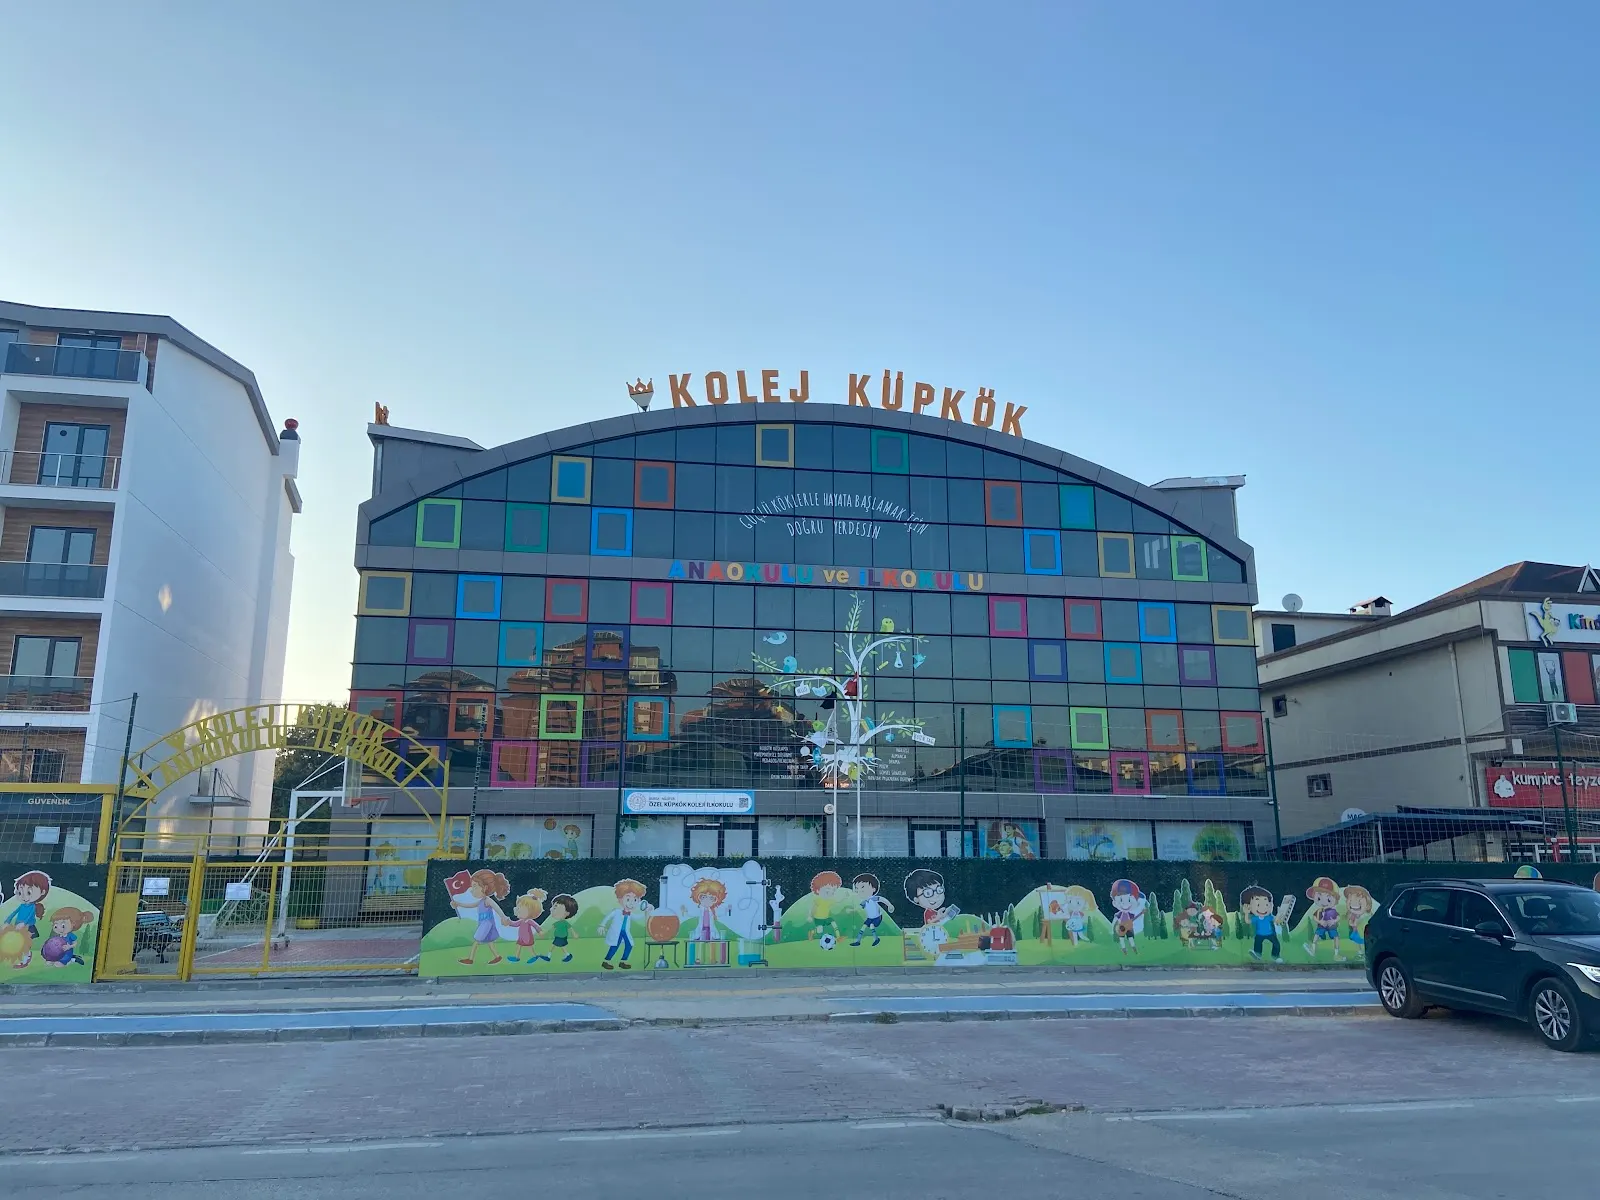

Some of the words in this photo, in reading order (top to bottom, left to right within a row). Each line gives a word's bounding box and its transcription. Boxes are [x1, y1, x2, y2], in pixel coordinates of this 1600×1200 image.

[669, 370, 809, 408] KOLEJ
[849, 369, 1029, 437] KÜPKÖK
[739, 500, 772, 530] GÜÇLÜ
[770, 492, 820, 513] KÖKLERLE
[823, 493, 852, 508] HAYATA
[855, 494, 907, 521] BAŞLAMAK
[786, 517, 824, 537] DOĞRU
[833, 520, 881, 539] YERDESİN
[668, 559, 813, 584] ANAOKULU
[823, 567, 849, 584] ve
[859, 569, 984, 591] İLKOKULU
[196, 704, 274, 743] KOLEJ
[158, 726, 283, 785] ANAOKULU
